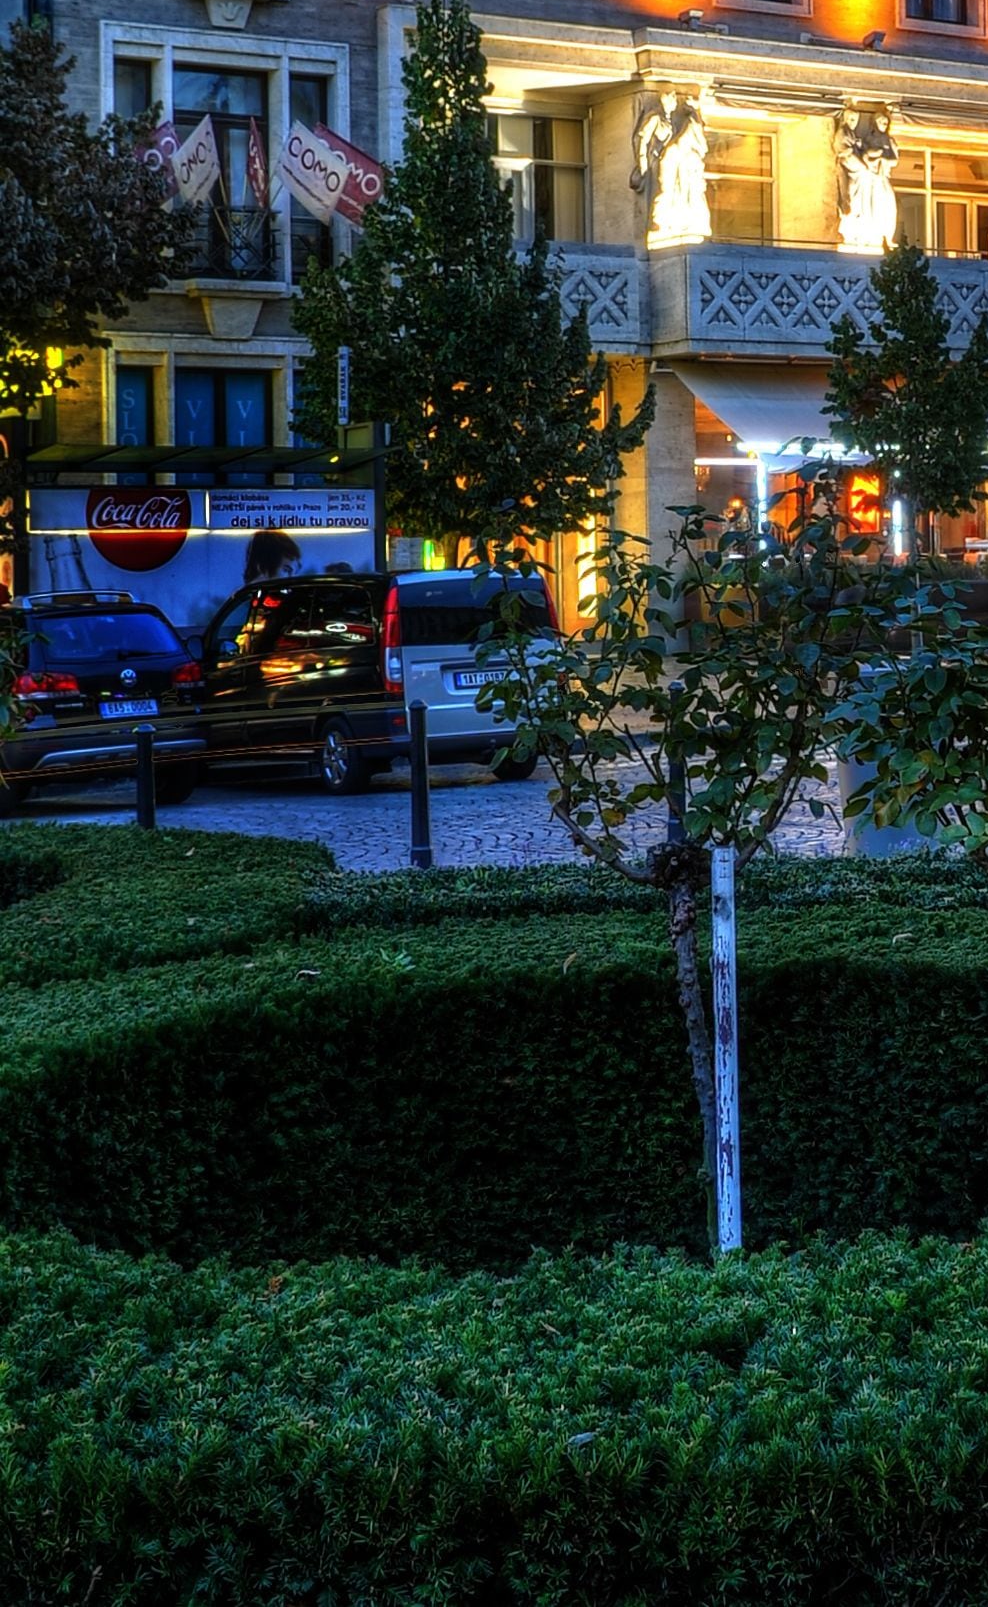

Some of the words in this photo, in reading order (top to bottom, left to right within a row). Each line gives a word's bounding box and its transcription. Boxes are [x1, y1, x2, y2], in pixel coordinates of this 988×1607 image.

[288, 136, 340, 192] COMO
[92, 496, 185, 528] Coca-Cola
[231, 515, 250, 528] dej
[255, 515, 264, 527] si
[268, 515, 276, 527] k
[279, 514, 306, 528] jídlu
[310, 516, 322, 527] tu
[326, 516, 369, 528] pravou
